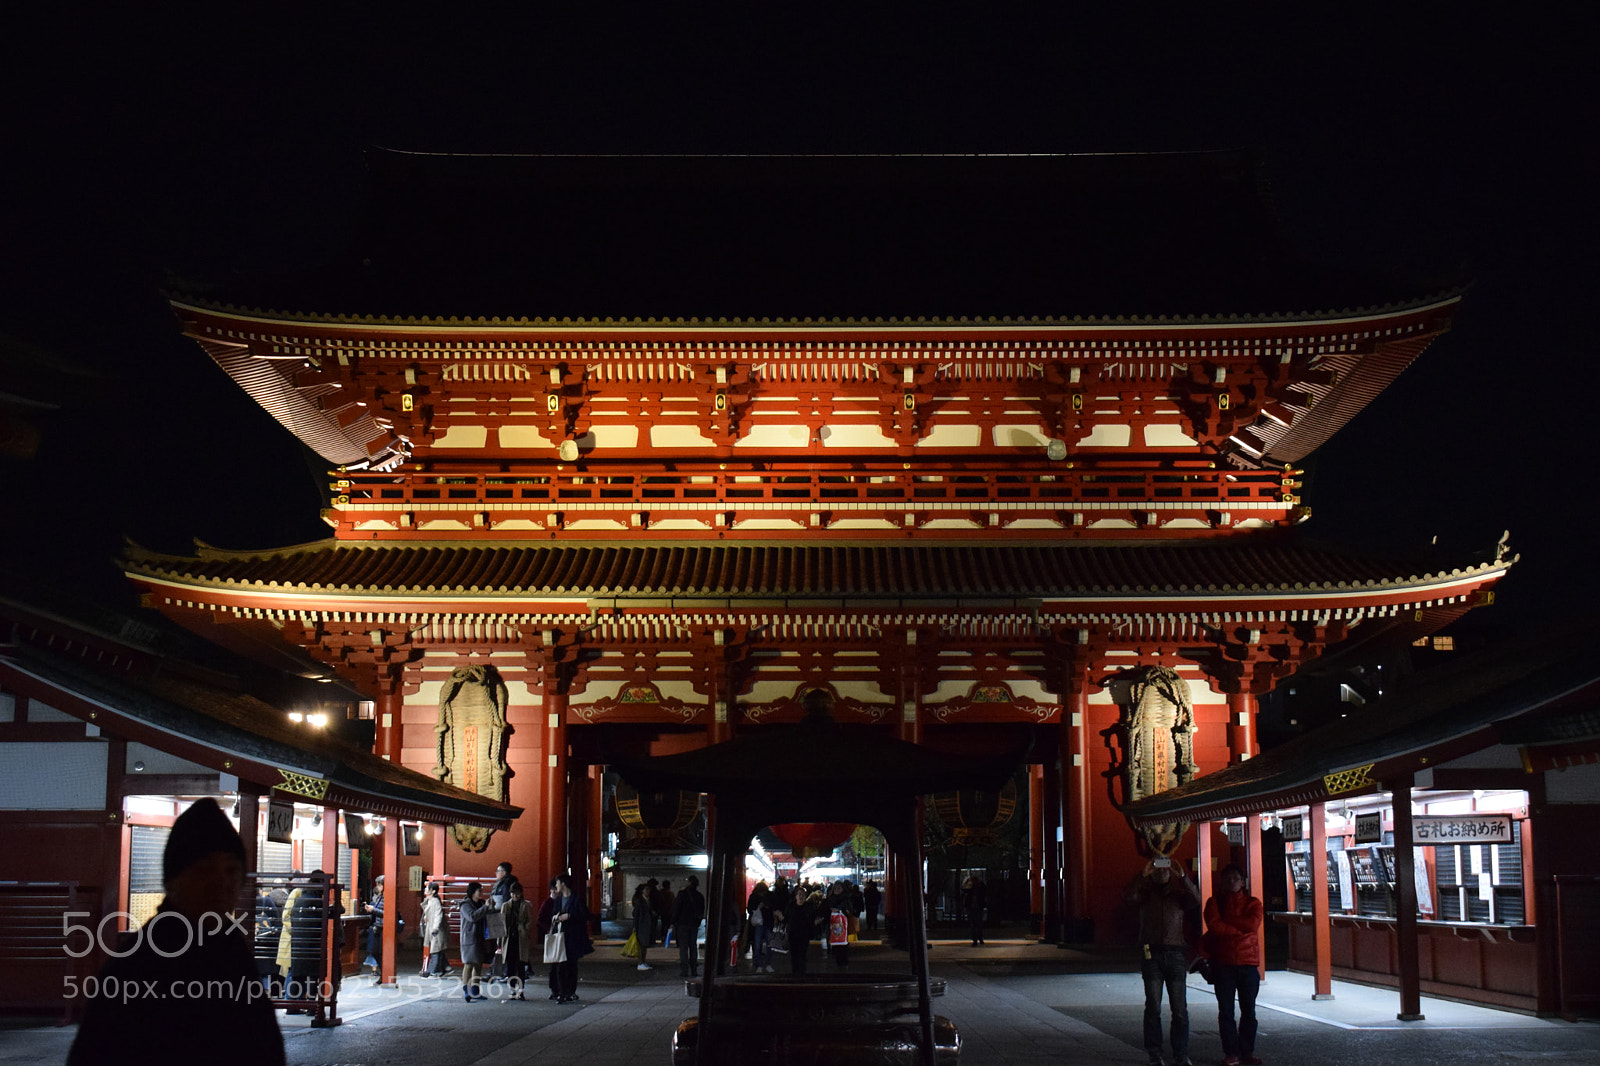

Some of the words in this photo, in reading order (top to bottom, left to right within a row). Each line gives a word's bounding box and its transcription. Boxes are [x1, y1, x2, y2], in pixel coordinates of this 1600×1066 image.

[1415, 820, 1506, 839] 古札お納め所
